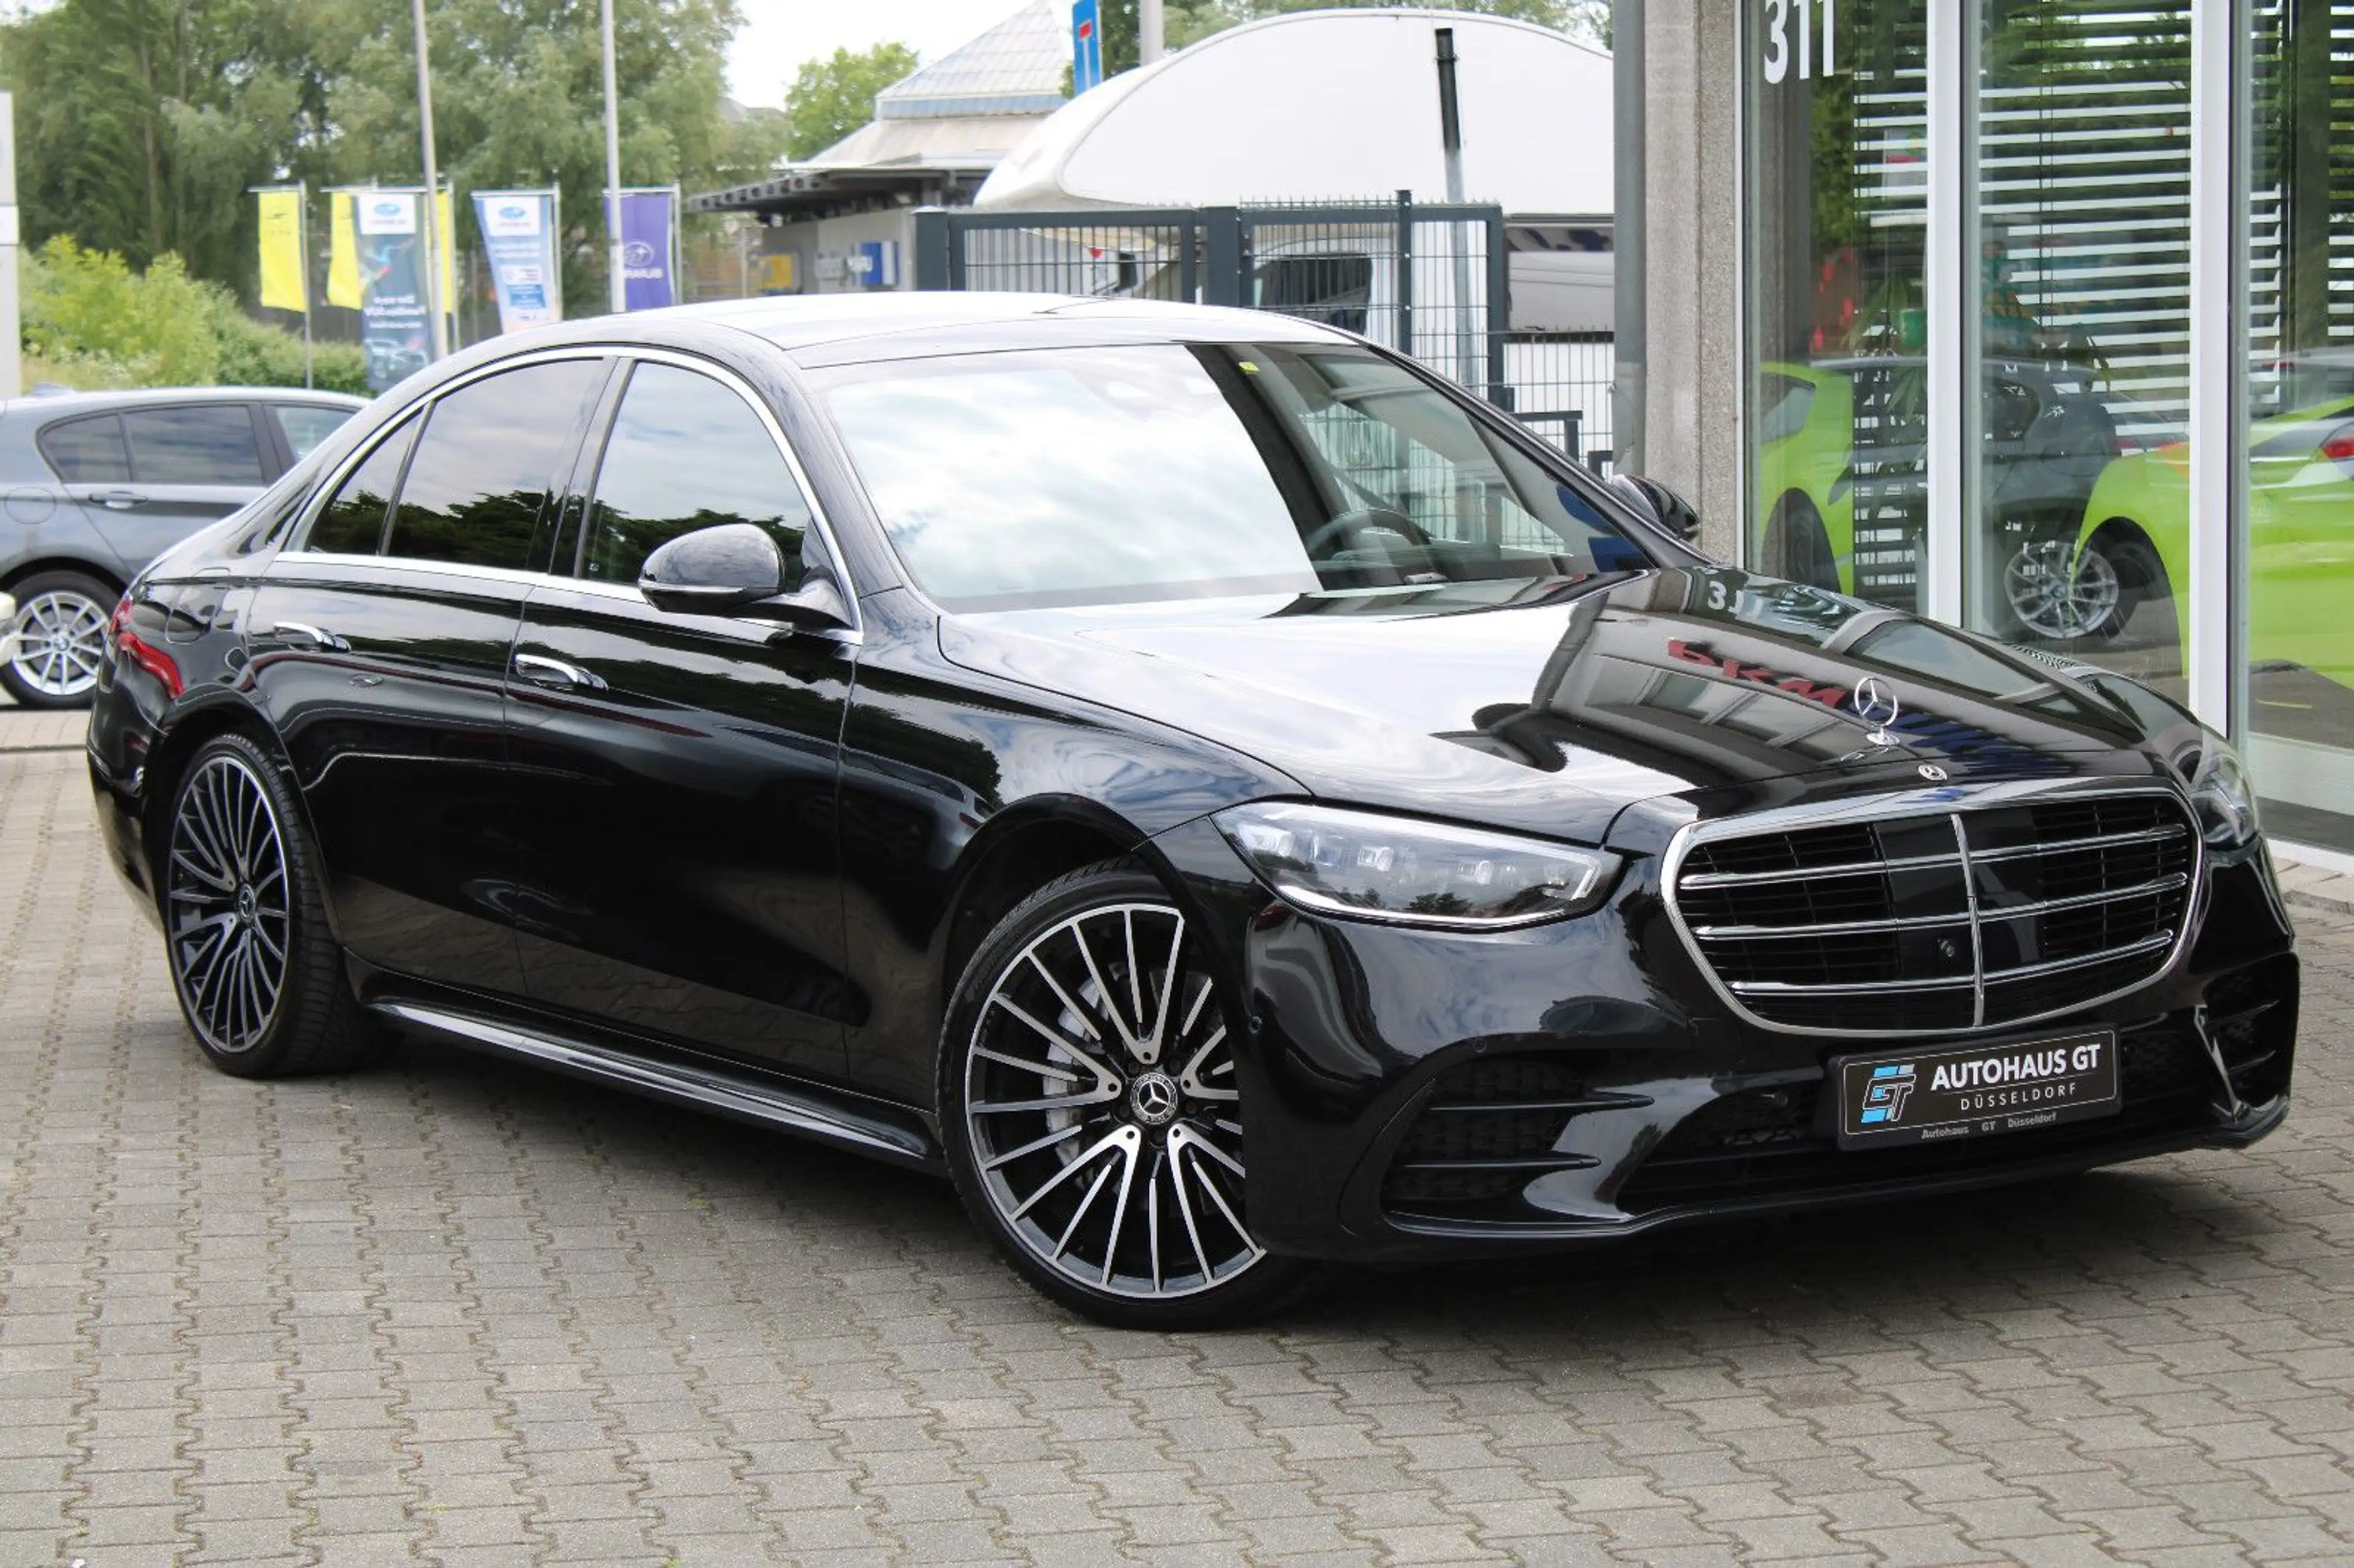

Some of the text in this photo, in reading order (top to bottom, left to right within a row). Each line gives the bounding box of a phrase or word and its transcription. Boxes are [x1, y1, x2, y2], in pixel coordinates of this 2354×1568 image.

[1764, 0, 1834, 84] 311
[1930, 1044, 2101, 1091] AUTOHAUS GT
[1960, 1083, 2076, 1111] DÜSSELDORF
[1921, 1111, 2057, 1140] Autohaus GT Düsseldorf
